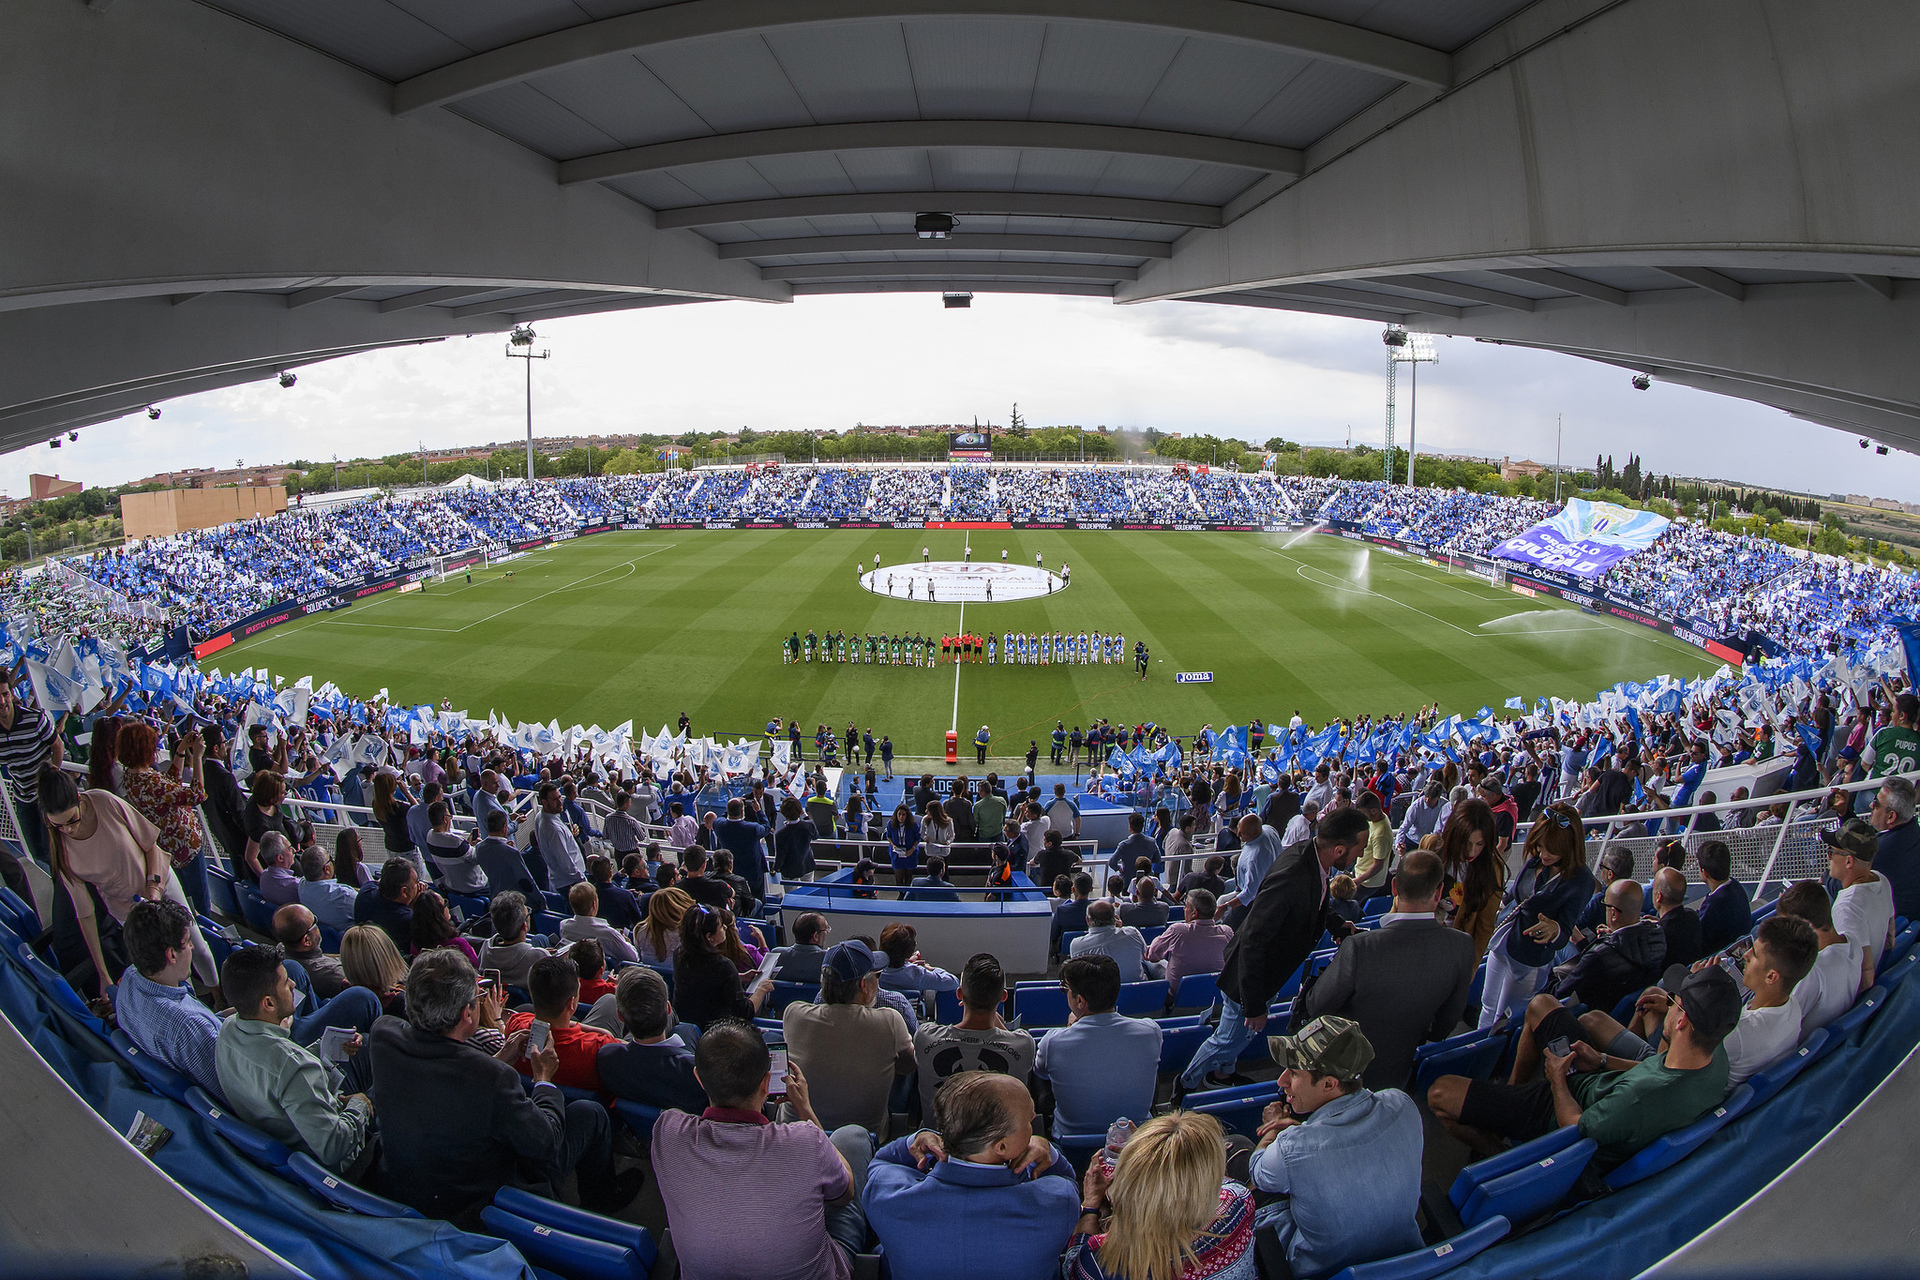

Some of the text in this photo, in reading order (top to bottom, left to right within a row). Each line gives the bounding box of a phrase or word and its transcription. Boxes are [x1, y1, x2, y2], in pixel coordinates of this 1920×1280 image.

[1505, 539, 1599, 572] CIUDAD
[356, 586, 377, 597] APUESTAS
[381, 581, 396, 590] CASINO
[1512, 577, 1531, 586] APUESTAS
[1535, 584, 1549, 592] CASINO
[245, 621, 266, 635] APUESTAS
[270, 613, 289, 625] CASINO
[1611, 607, 1635, 620] APUESTAS
[1639, 616, 1658, 627] CASINO
[1895, 739, 1917, 751] PUPUS
[1880, 753, 1916, 775] 20
[924, 1040, 943, 1054] ONCE
[982, 1039, 1022, 1061] WARRIORS
